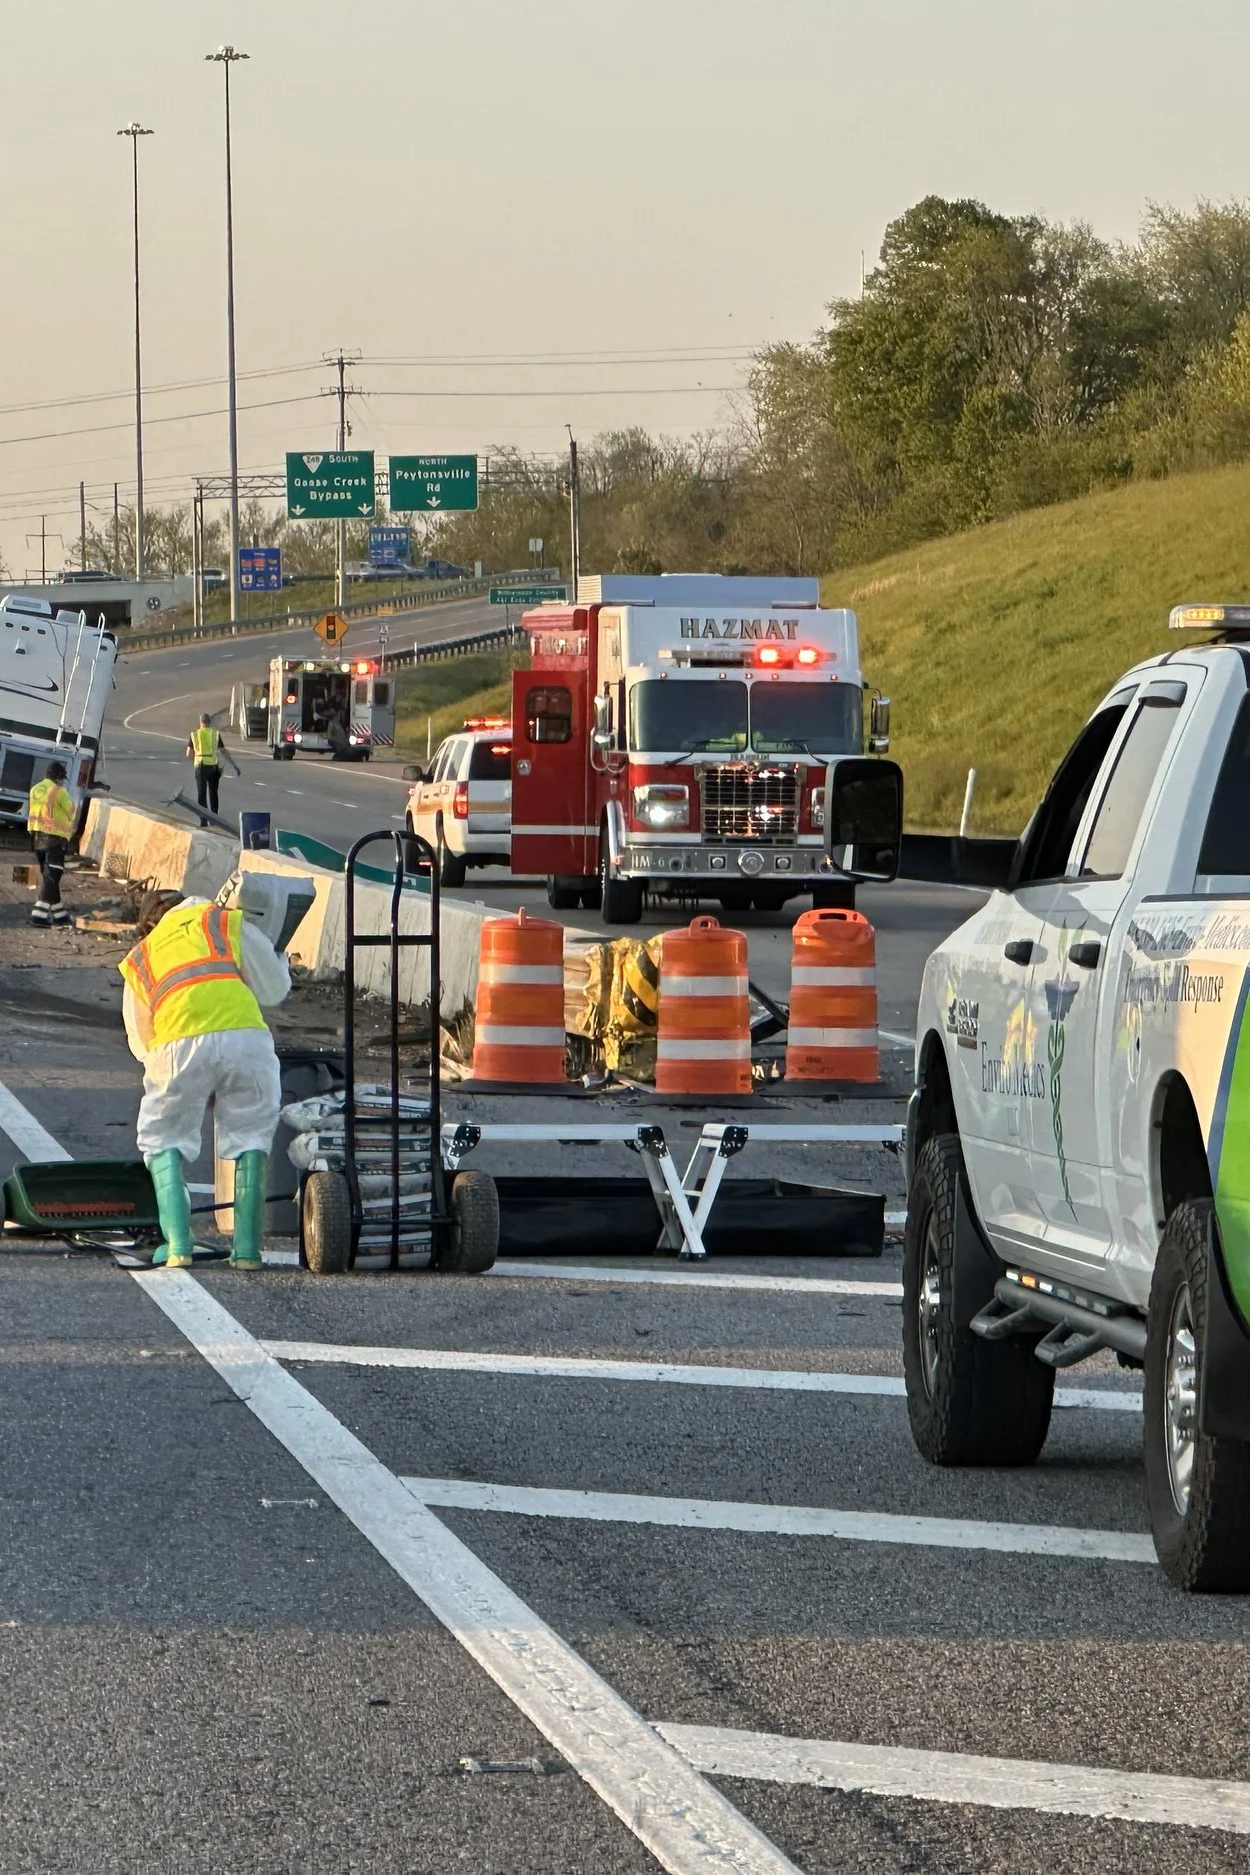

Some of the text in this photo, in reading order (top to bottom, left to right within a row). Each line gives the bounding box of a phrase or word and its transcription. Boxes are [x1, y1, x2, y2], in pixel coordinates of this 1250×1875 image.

[418, 458, 448, 466] NORTH
[395, 468, 471, 481] Peytonsville
[294, 476, 367, 487] Goose Creek
[426, 482, 441, 493] Rd
[309, 490, 352, 502] Bypass
[680, 617, 799, 640] HAZMAT
[1180, 965, 1224, 1013] Response
